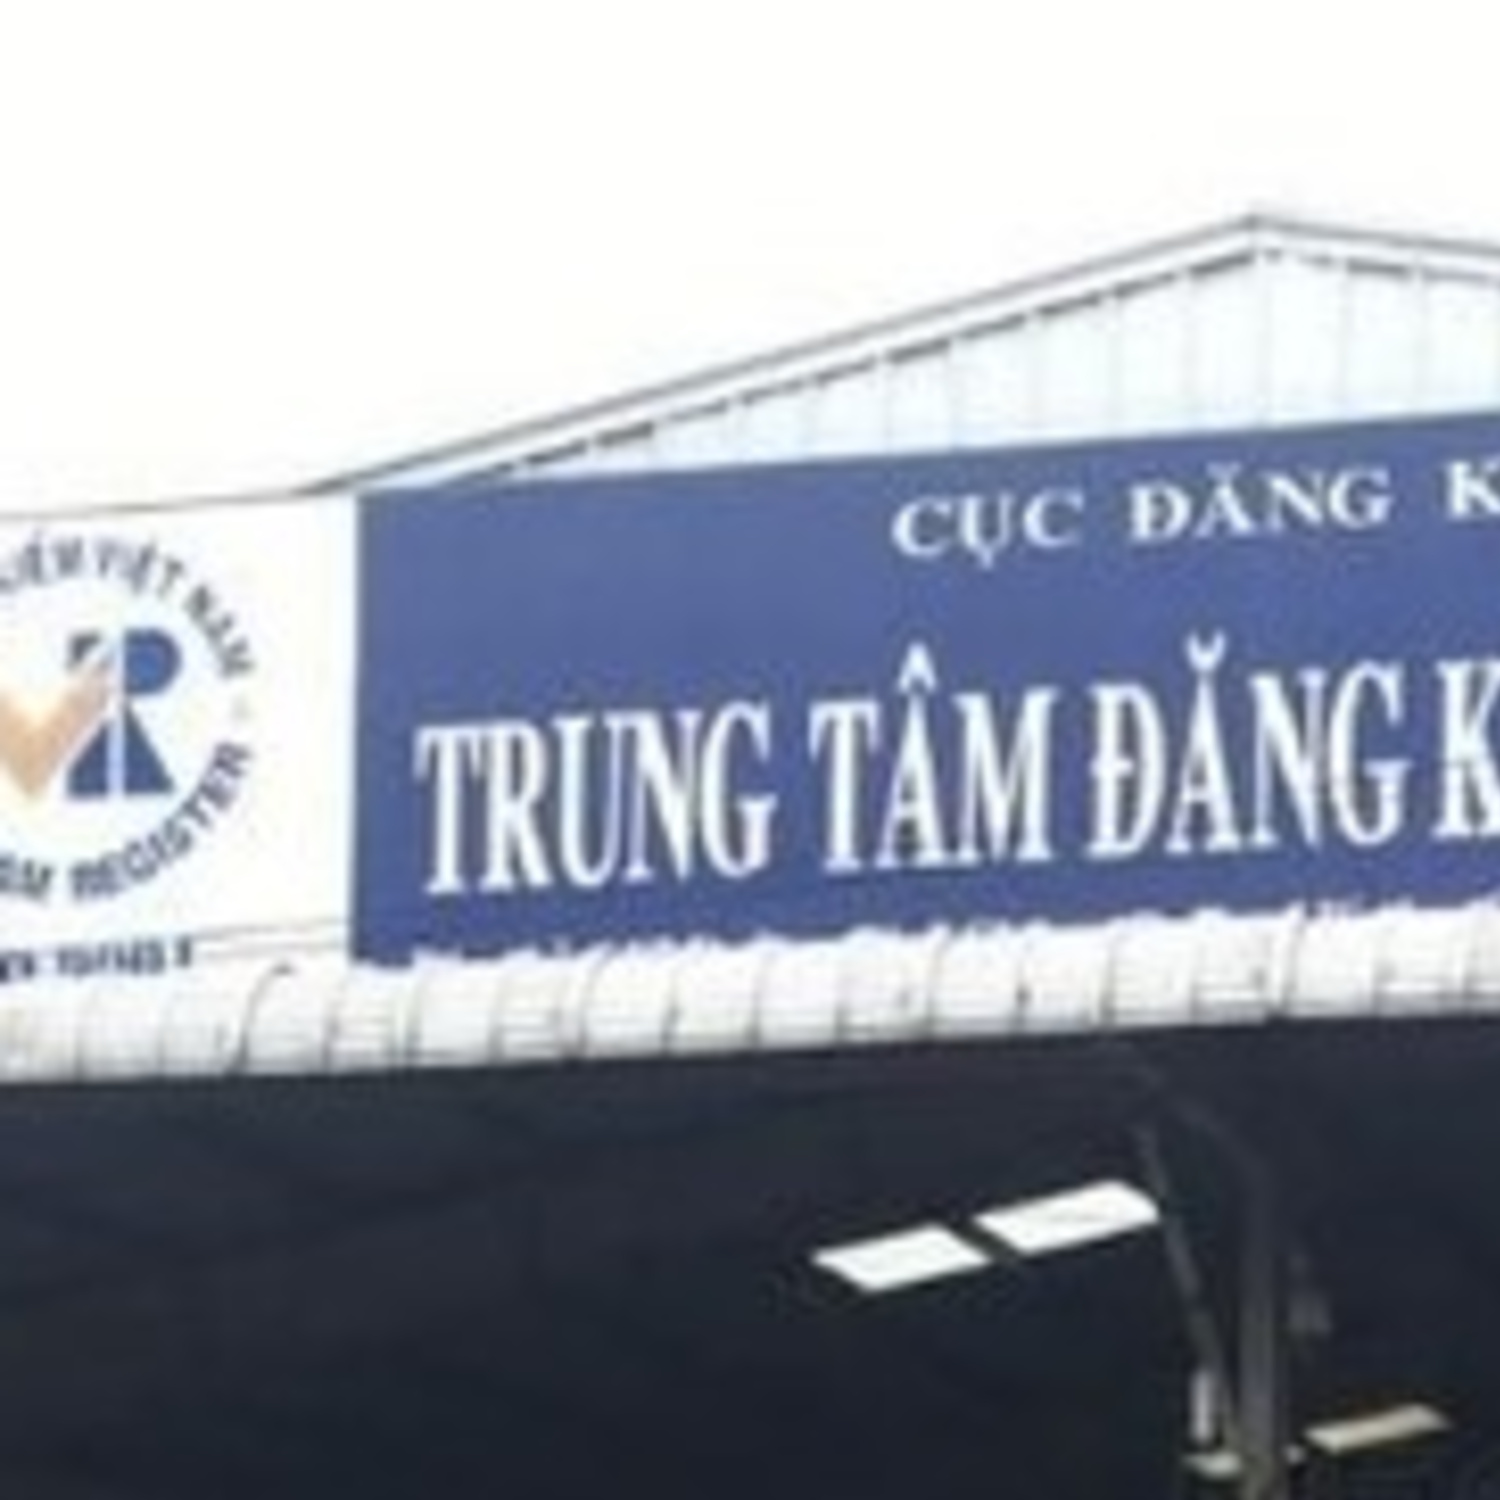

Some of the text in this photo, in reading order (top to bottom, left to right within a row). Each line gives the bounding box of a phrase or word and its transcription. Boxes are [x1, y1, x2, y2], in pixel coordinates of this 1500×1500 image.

[891, 493, 1084, 568] CỤC
[1129, 462, 1391, 543] ĐĂNG
[415, 700, 778, 895] TRUNG
[808, 643, 1058, 872] TÂM
[1086, 631, 1410, 860] ĐĂNG
